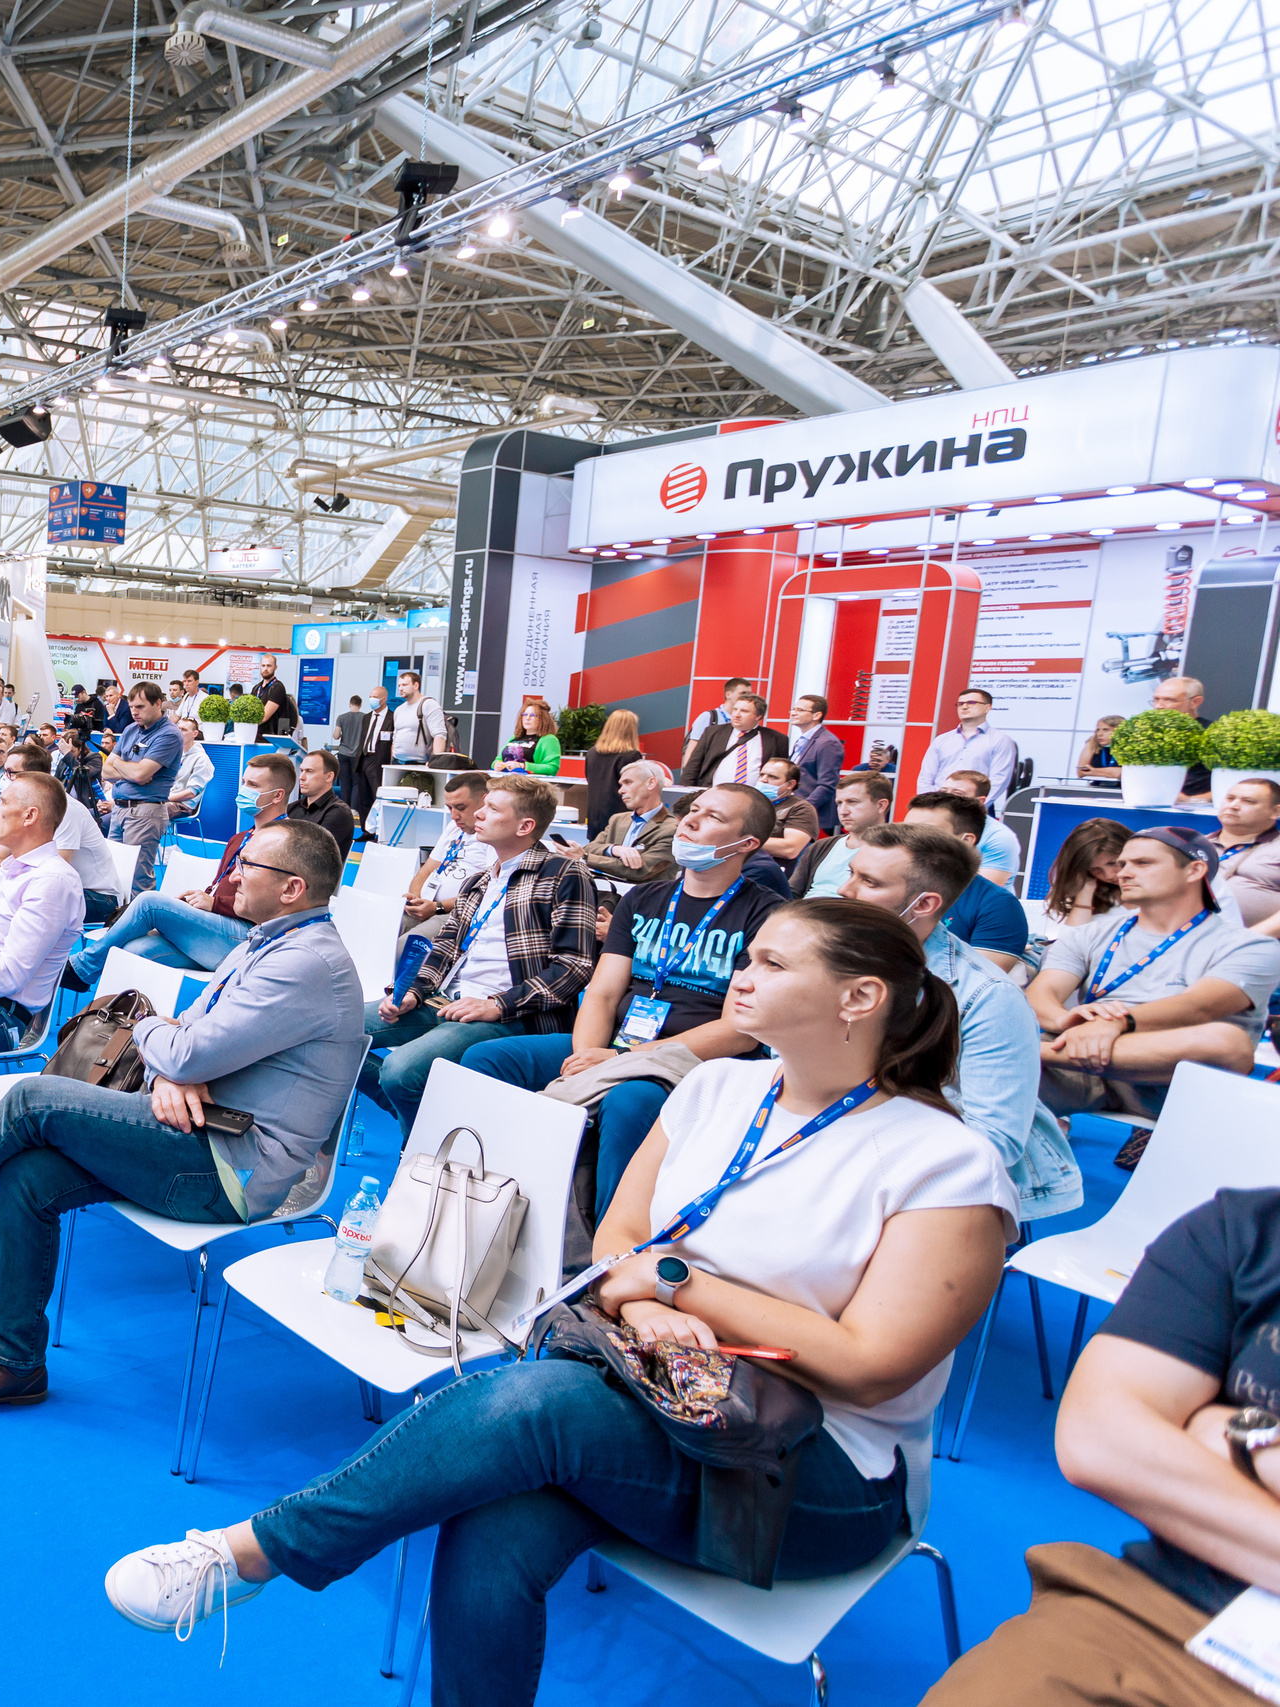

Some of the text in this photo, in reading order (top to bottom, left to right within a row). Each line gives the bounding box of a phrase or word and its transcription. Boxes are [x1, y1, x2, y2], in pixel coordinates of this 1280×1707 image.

[973, 405, 1029, 429] НПЦ
[724, 427, 1027, 503] Пружина
[129, 657, 169, 671] MUTLU
[454, 559, 474, 705] www.npc-springs.ru
[523, 572, 538, 687] ОБЪЕДИНЕННАЯ
[531, 613, 543, 687] ВАГОННАЯ
[539, 609, 551, 687] КОМПАНИЯ
